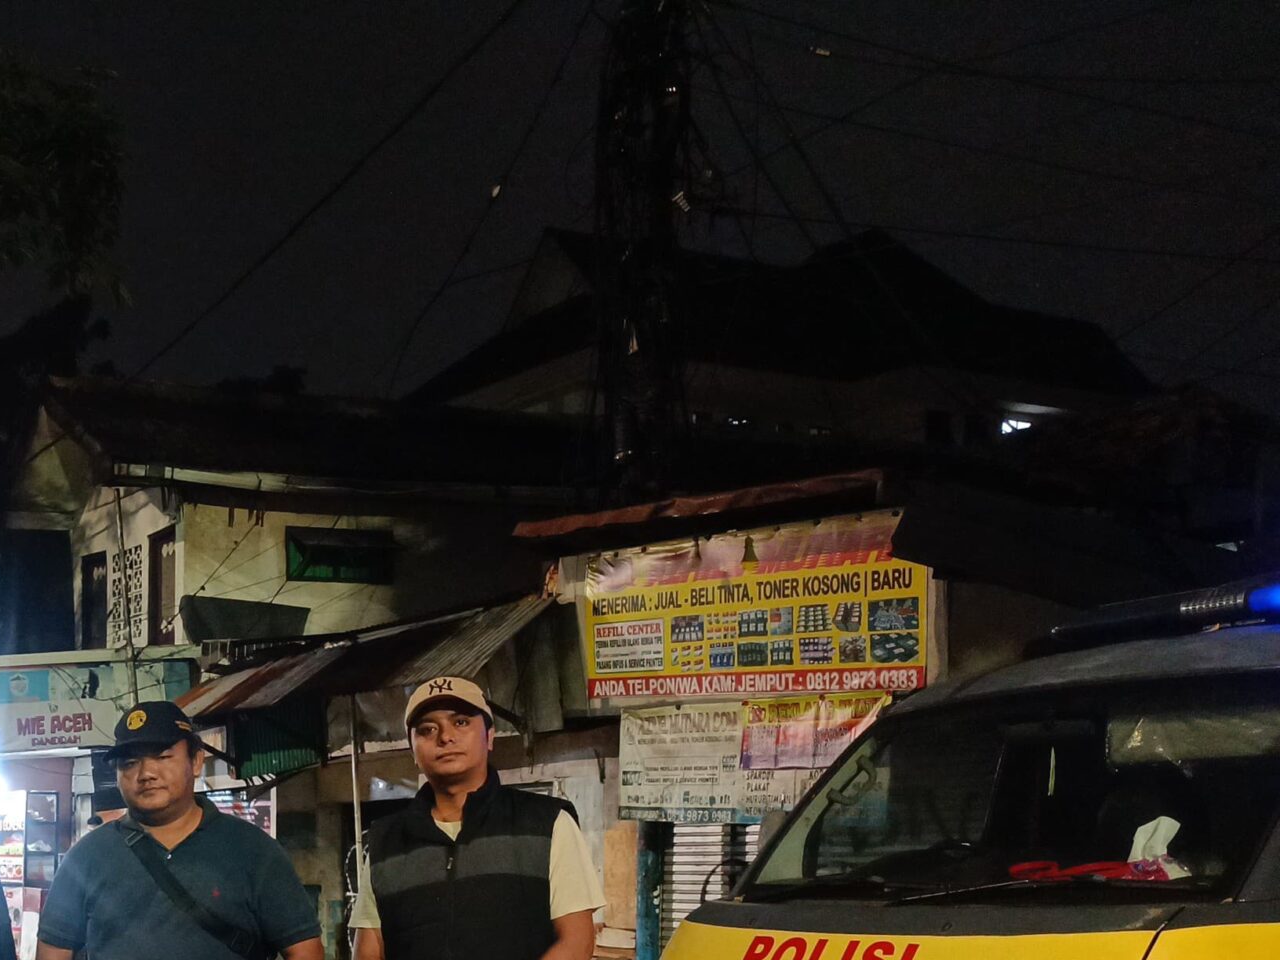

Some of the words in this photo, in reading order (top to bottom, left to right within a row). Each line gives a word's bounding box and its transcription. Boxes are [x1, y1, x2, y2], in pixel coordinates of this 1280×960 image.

[592, 594, 646, 616] MENERIMA
[654, 591, 682, 609] JUAL
[690, 585, 715, 607] BELI
[717, 581, 754, 605] TINTA,
[756, 578, 799, 601] TONER
[802, 572, 861, 597] KOSONG
[871, 567, 913, 591] BARU
[596, 626, 625, 638] REFILL
[627, 623, 662, 635] CENTER
[593, 680, 626, 697] ANDA
[737, 673, 795, 693] JEMPUT
[806, 673, 840, 691] 0812
[843, 671, 876, 690] 9873
[879, 669, 917, 688] 0383
[16, 715, 45, 736] MIE
[50, 713, 93, 734] ACEH
[686, 810, 709, 821] 9873
